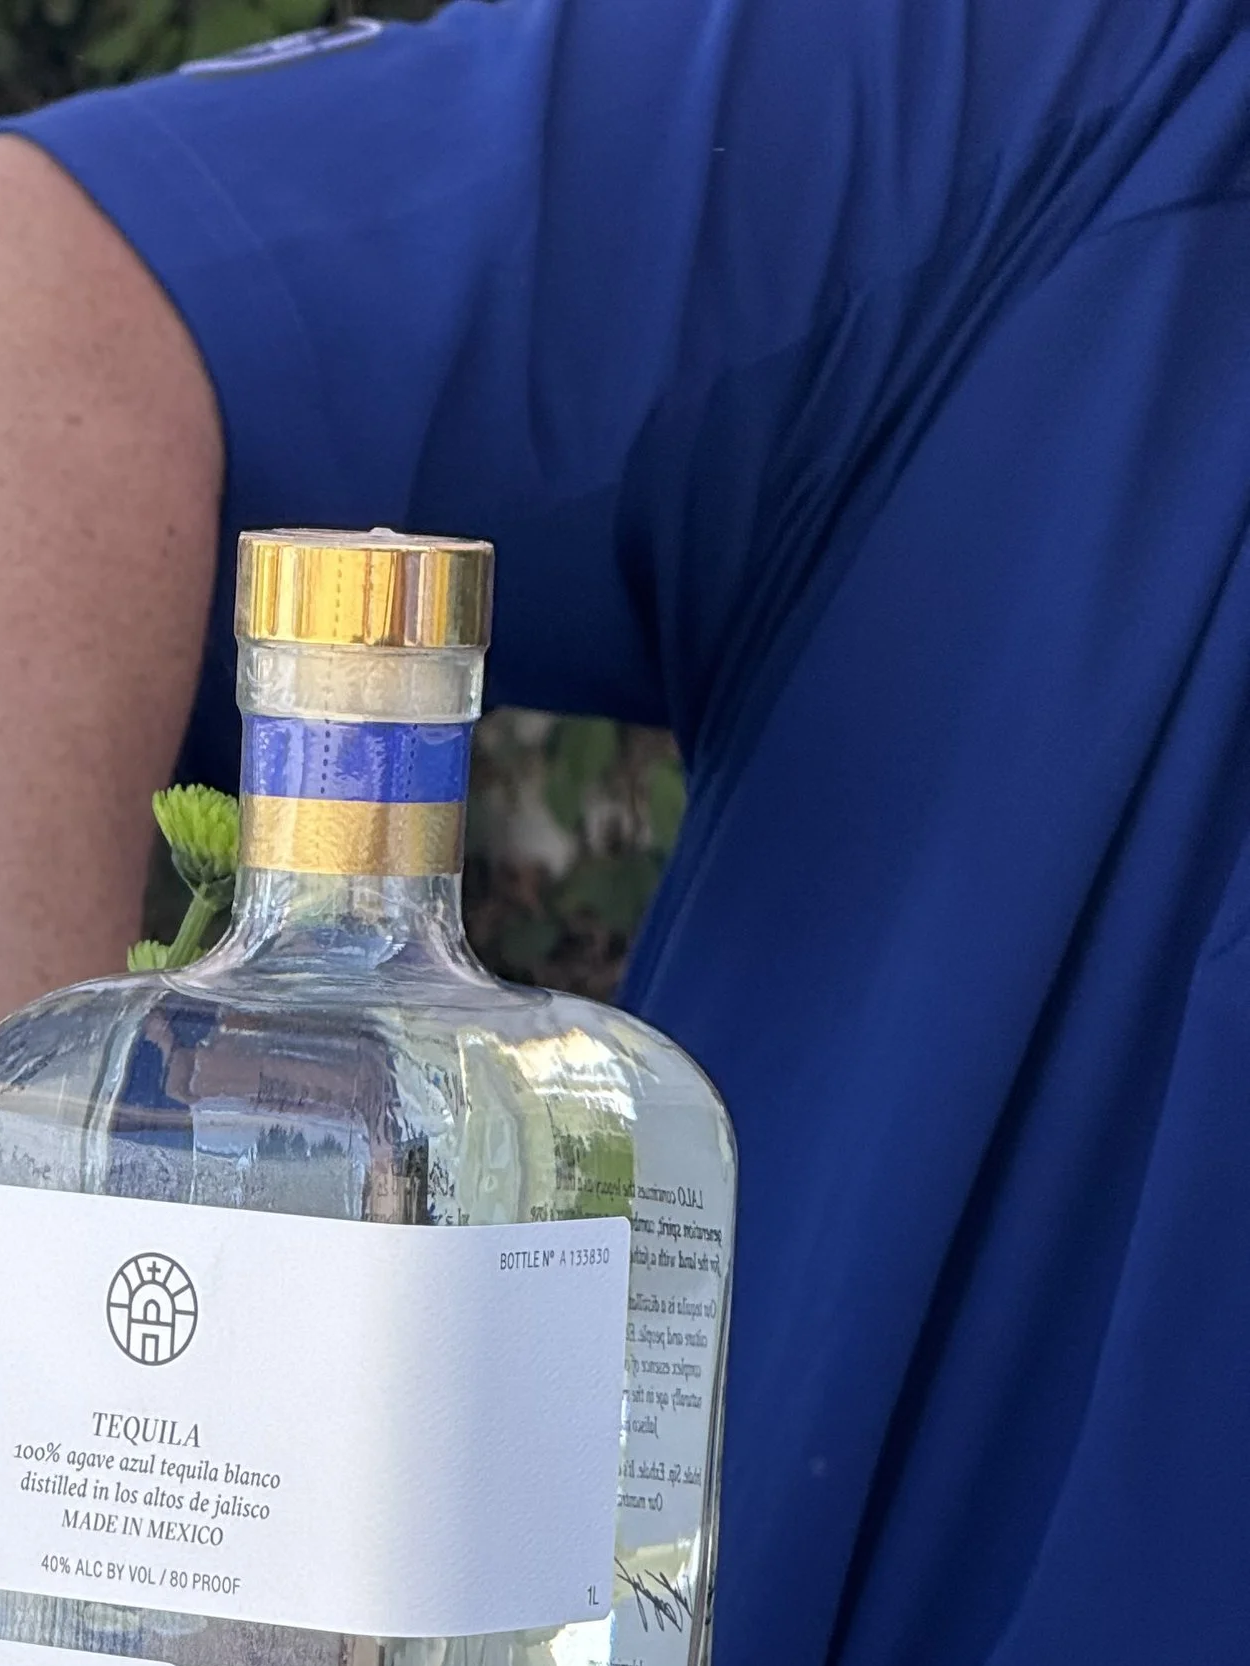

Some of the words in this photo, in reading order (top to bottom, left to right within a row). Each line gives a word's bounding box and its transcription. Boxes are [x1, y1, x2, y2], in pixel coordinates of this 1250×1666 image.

[500, 1250, 539, 1270] BOTTLE
[559, 1250, 567, 1268] A
[570, 1248, 610, 1266] 133830
[92, 1412, 201, 1448] TEQUILA
[13, 1442, 62, 1463] 100%
[67, 1450, 114, 1472] agave
[119, 1455, 155, 1474] azul
[160, 1458, 219, 1484] tequila
[224, 1463, 281, 1489] blanco
[20, 1471, 88, 1498] distilled
[93, 1480, 109, 1501] in
[115, 1483, 138, 1504] los
[143, 1487, 184, 1510] altos
[189, 1491, 210, 1512] de
[211, 1494, 271, 1520] jalisco
[61, 1509, 118, 1534] MADE
[122, 1516, 144, 1537] IN
[148, 1519, 224, 1546] MEXICO
[41, 1555, 71, 1574] 40%
[75, 1558, 102, 1578] ALC
[107, 1562, 125, 1581] BY
[129, 1564, 156, 1585] VOL
[159, 1569, 167, 1586] /
[169, 1571, 187, 1589] 80
[192, 1573, 241, 1595] PROOF
[587, 1585, 600, 1606] 1L
